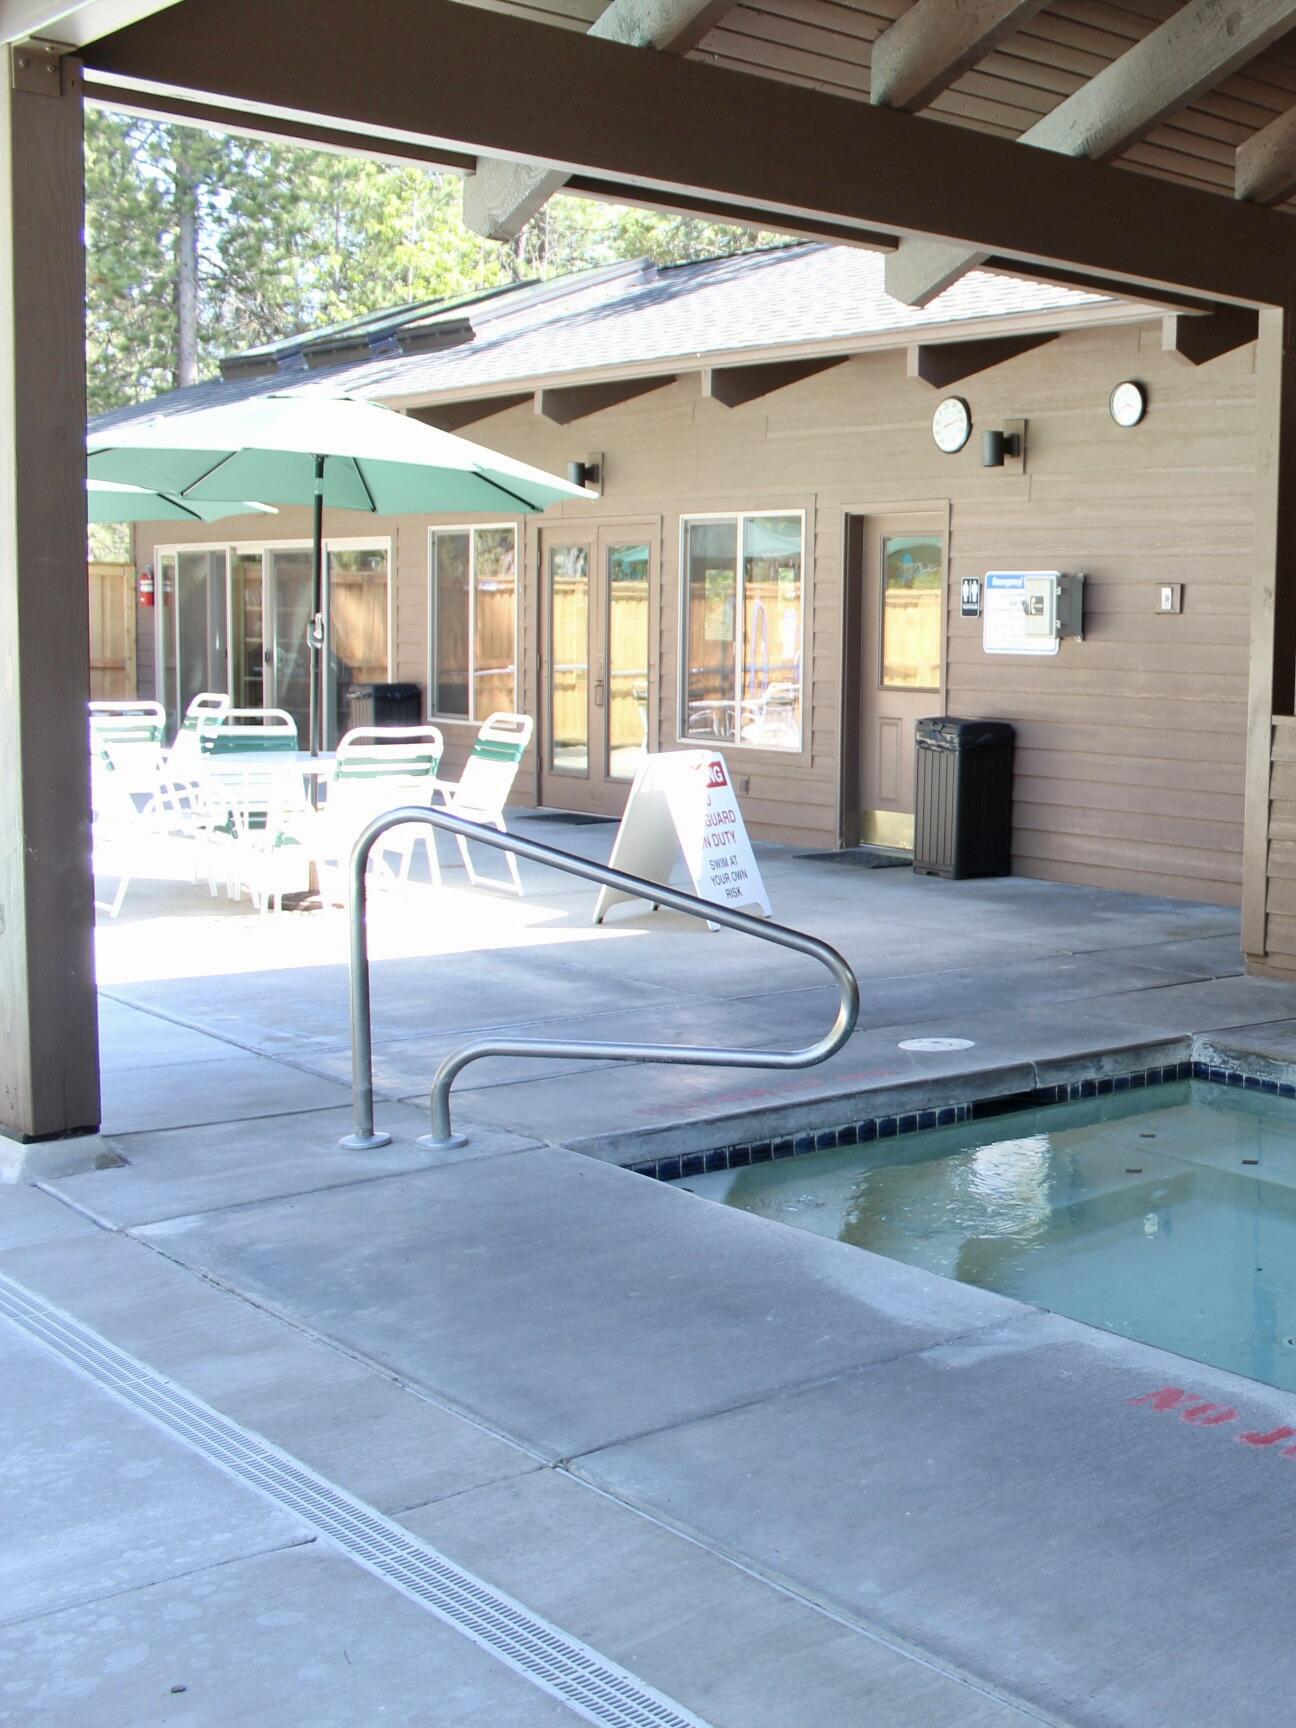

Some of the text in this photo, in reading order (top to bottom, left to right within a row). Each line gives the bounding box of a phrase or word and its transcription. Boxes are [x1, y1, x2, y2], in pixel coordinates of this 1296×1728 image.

[704, 809, 737, 828] GUARD
[712, 830, 736, 847] DUTY
[709, 855, 738, 870] SWIM AT
[710, 869, 749, 887] YOUR OWN
[725, 887, 743, 899] RISK
[1127, 1386, 1239, 1427] NO
